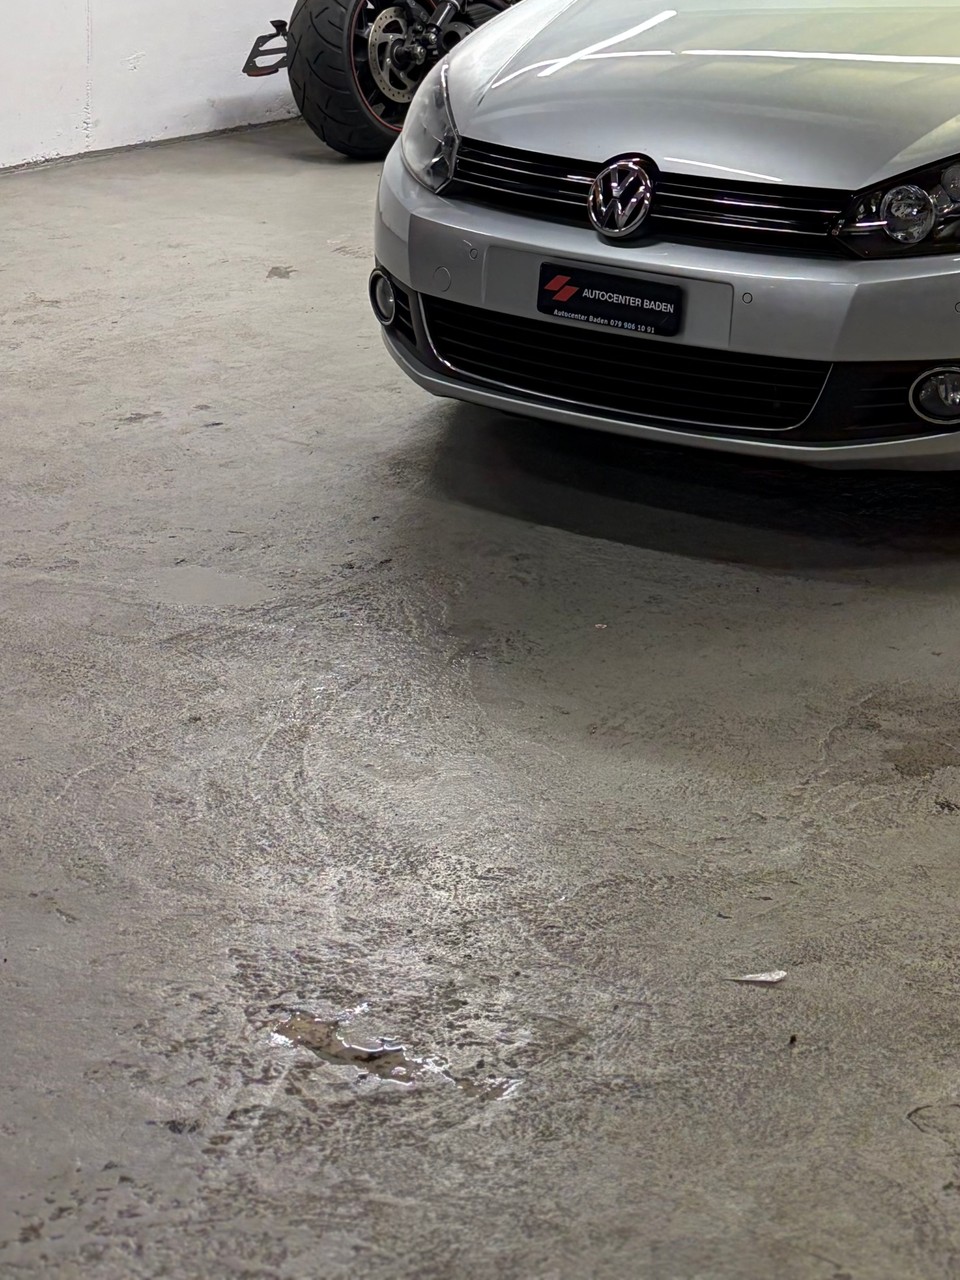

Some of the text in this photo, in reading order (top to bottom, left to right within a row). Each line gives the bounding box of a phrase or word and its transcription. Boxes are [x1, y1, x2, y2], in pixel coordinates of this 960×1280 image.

[591, 162, 649, 232] VW
[582, 288, 675, 313] AUTOCENTER BADEN
[553, 308, 588, 321] Autocenter
[588, 315, 609, 325] Baden
[610, 319, 622, 328] 079
[637, 324, 646, 332] 10
[646, 326, 655, 334] 91
